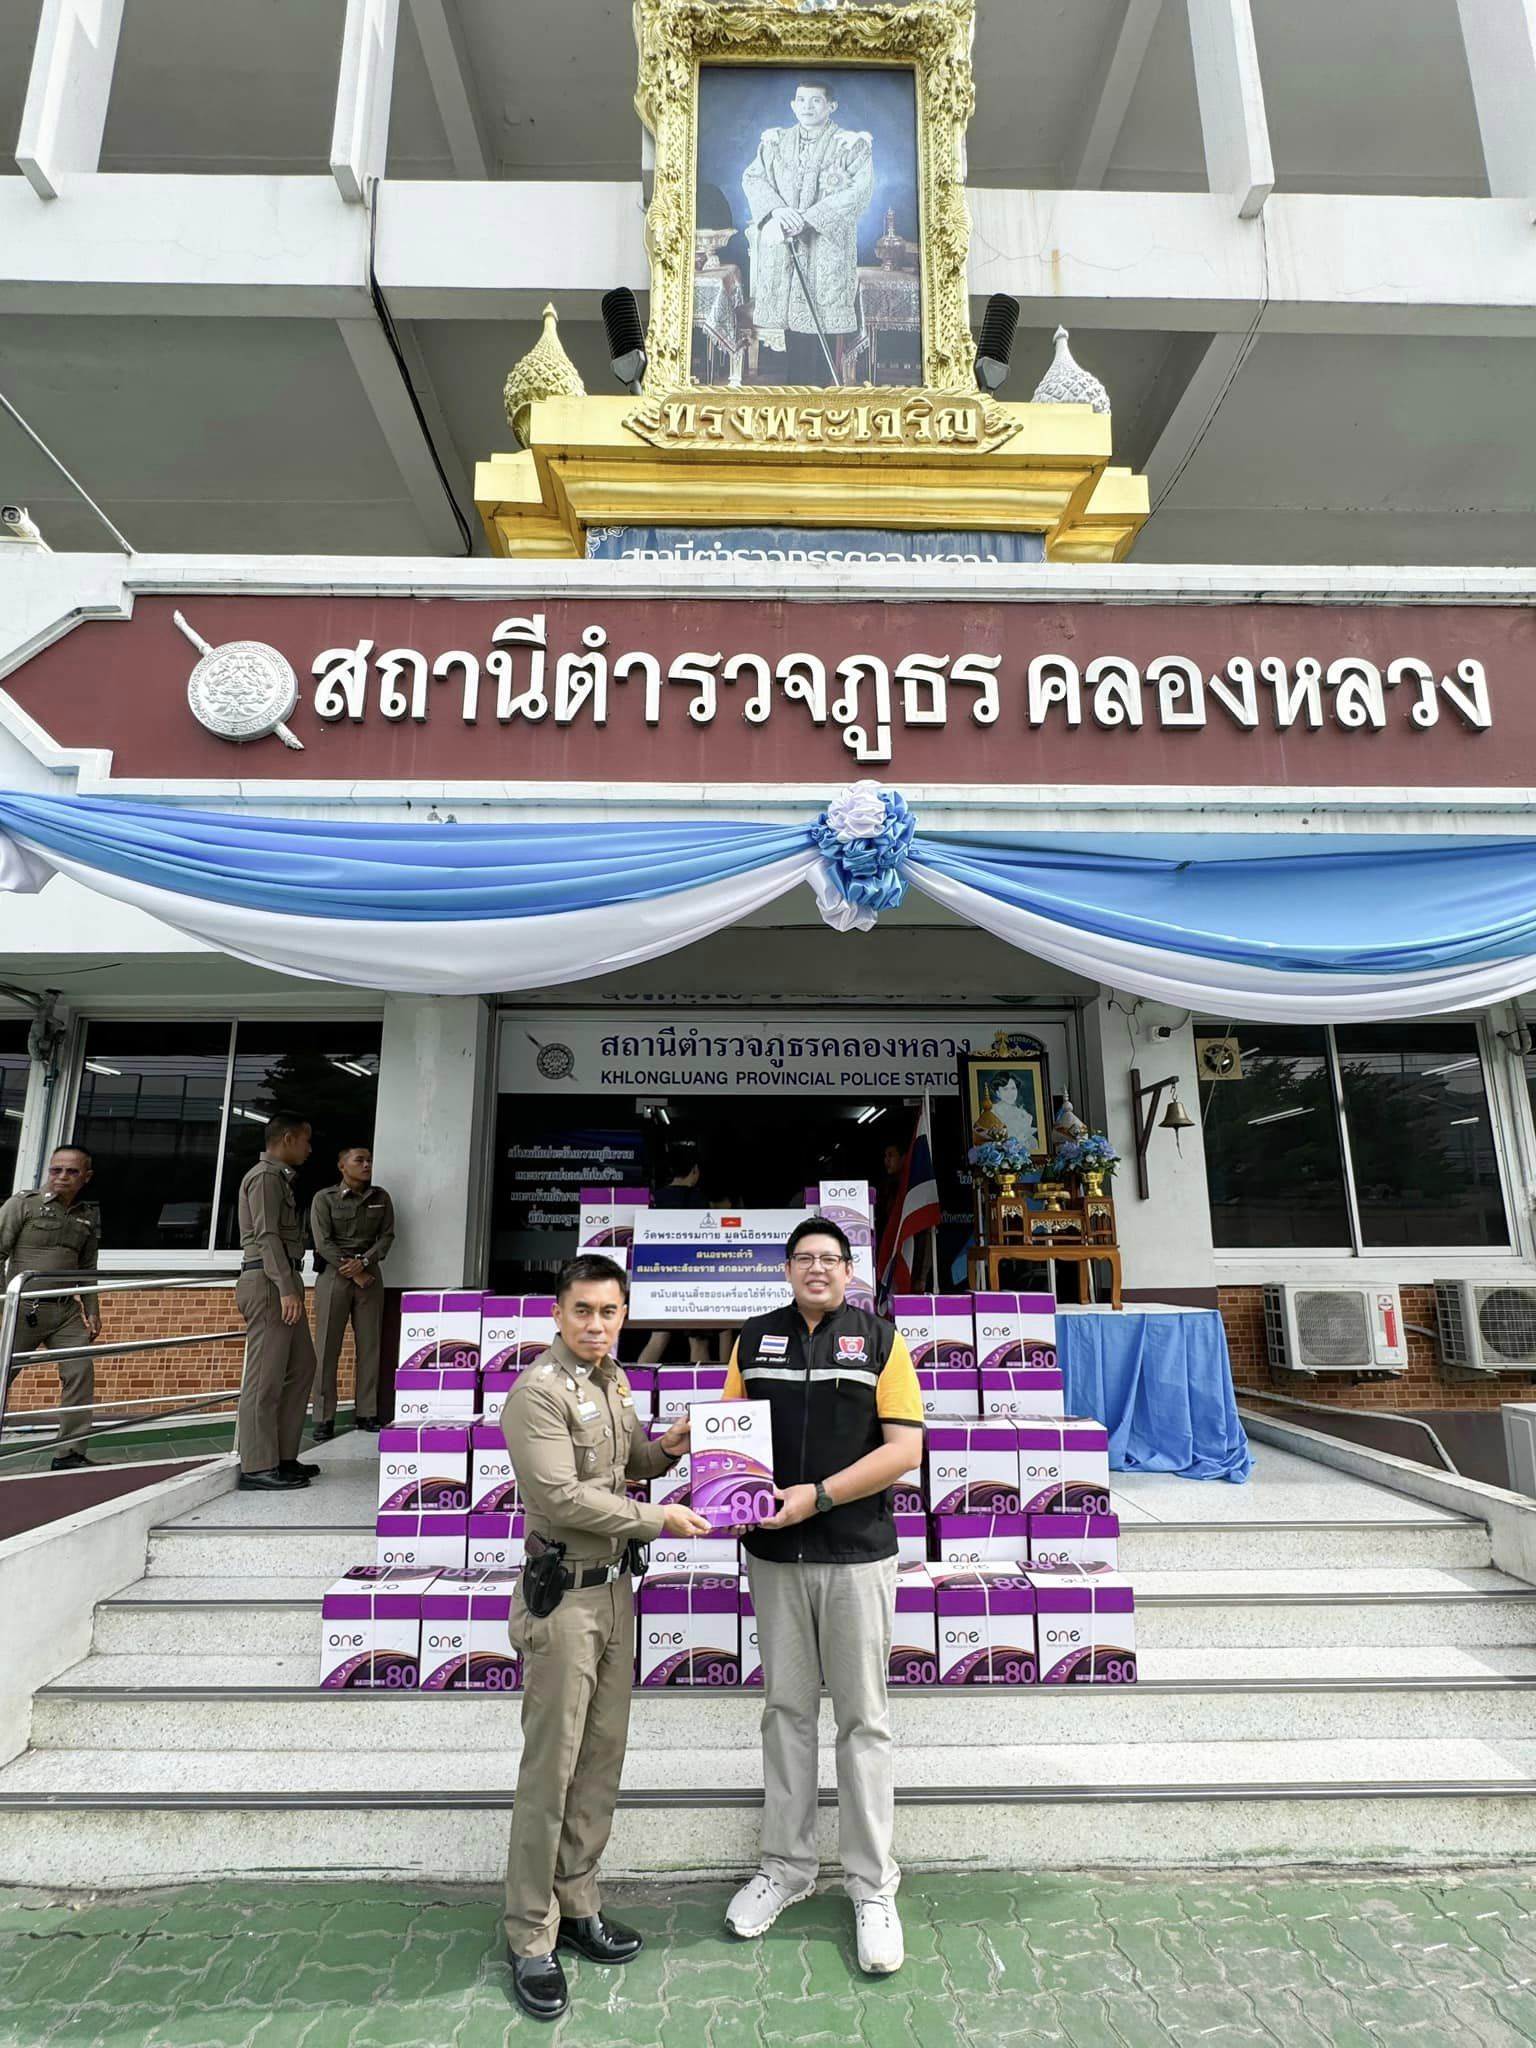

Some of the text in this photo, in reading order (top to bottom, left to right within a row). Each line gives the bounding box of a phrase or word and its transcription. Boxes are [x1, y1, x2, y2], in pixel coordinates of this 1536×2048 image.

[662, 396, 978, 444] ทรงพระเจริญ
[311, 613, 1492, 764] สถานีตำรวจภูธร คลองหลวง
[600, 1026, 971, 1068] สถานีตำรวจภูธรคลองหลวง
[601, 1071, 960, 1087] KHLONGLUANG PROVINCIAL POLICE STATIO
[828, 1187, 858, 1198] one
[585, 1215, 610, 1224] one
[407, 1327, 436, 1338] one
[488, 1330, 516, 1340] one
[900, 1327, 928, 1337] one
[982, 1326, 1011, 1336] one
[454, 1351, 479, 1368] 80
[950, 1351, 974, 1368] 80
[1032, 1350, 1056, 1368] 80
[401, 1404, 429, 1414] one
[489, 1404, 506, 1414] on
[706, 1415, 752, 1433] one
[386, 1464, 418, 1476] one
[480, 1464, 511, 1476] one
[937, 1466, 968, 1478] one
[1026, 1466, 1058, 1478] one
[438, 1490, 466, 1510] 80
[894, 1493, 921, 1512] 80
[992, 1494, 1020, 1514] 80
[1082, 1494, 1110, 1516] 80
[731, 1490, 775, 1524] 80
[384, 1552, 415, 1563] one
[474, 1552, 506, 1562] one
[656, 1552, 688, 1562] one
[949, 1552, 980, 1562] one
[702, 1578, 738, 1590] 80
[993, 1578, 1032, 1589] 80
[328, 1634, 364, 1647] one
[428, 1635, 463, 1648] one
[649, 1632, 684, 1644] one
[945, 1630, 980, 1643] one
[1046, 1629, 1081, 1642] one
[386, 1665, 418, 1688] 80
[707, 1662, 738, 1685] 80
[906, 1660, 936, 1684] 80
[1004, 1660, 1035, 1684] 80
[1106, 1660, 1136, 1683] 80
[486, 1667, 517, 1690] 80
